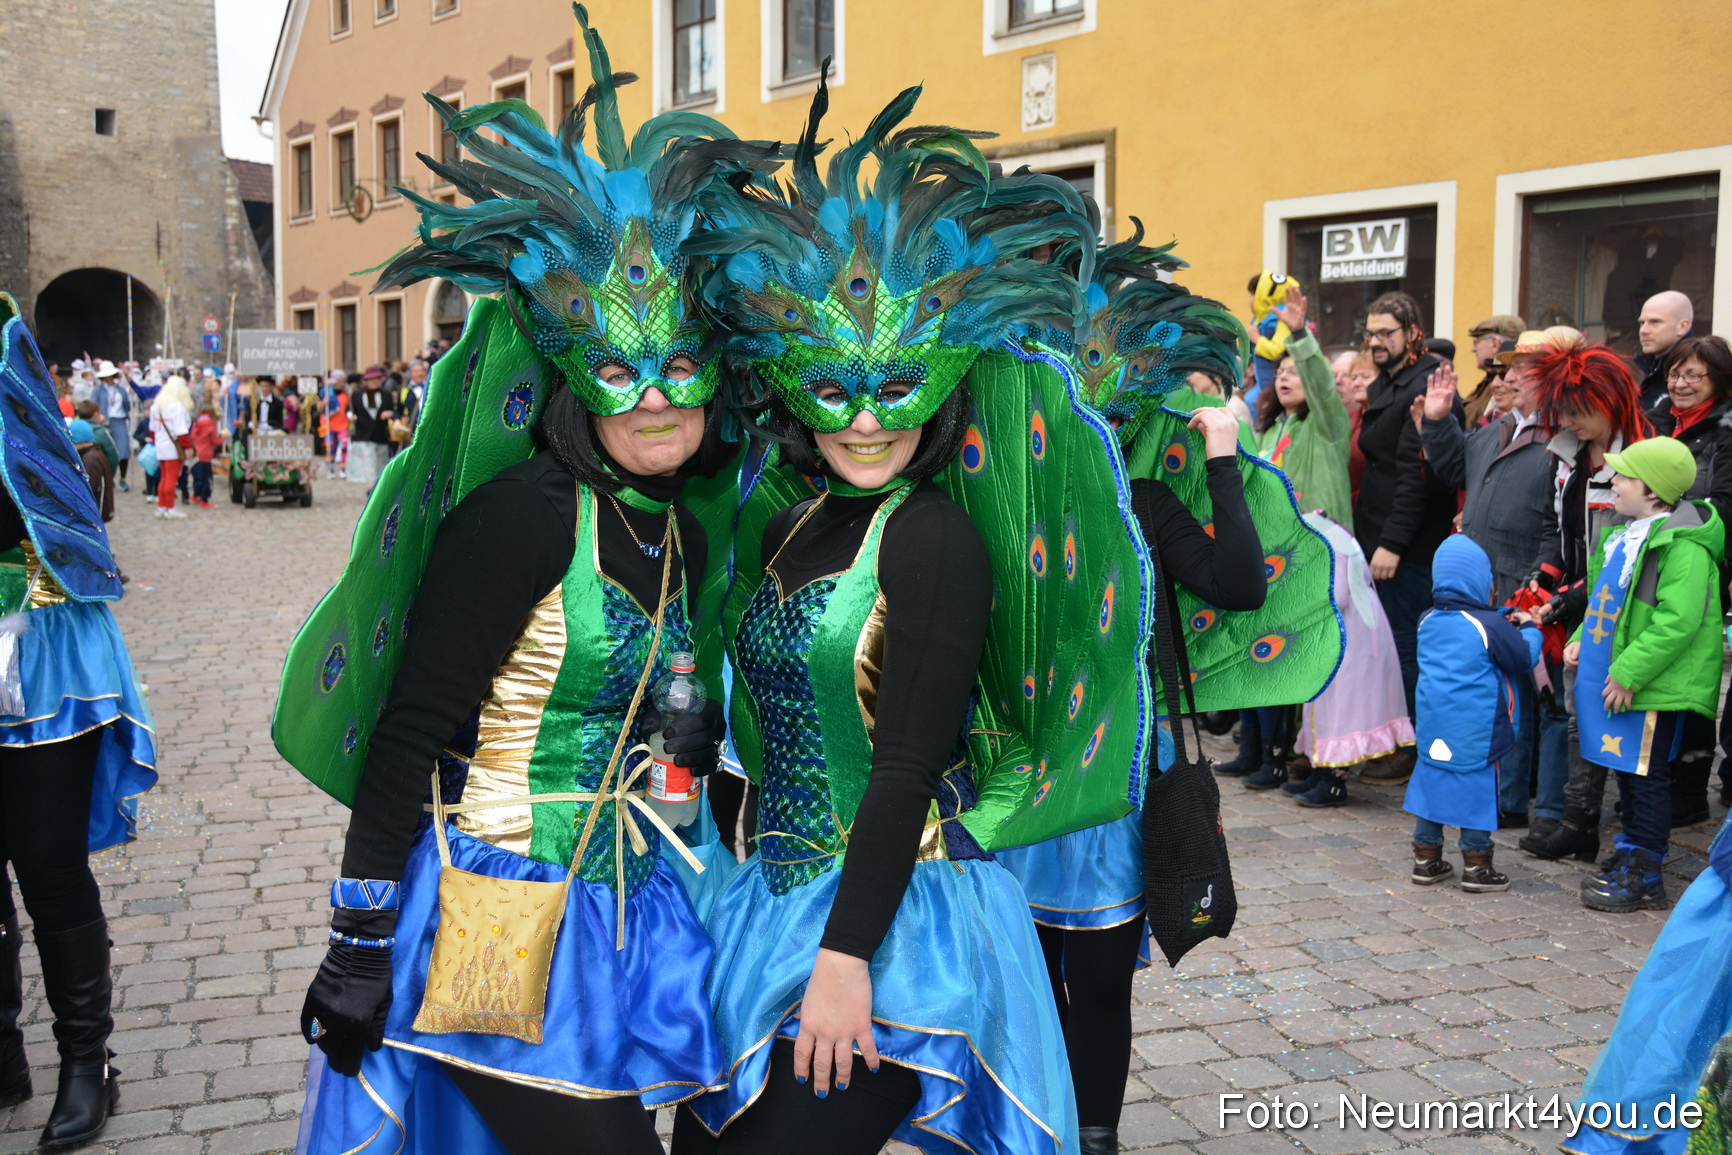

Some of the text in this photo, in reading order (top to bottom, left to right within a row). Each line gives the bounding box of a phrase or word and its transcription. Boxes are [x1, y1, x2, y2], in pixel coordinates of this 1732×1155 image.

[1326, 223, 1401, 258] BW
[1321, 260, 1404, 279] Bekleidung
[266, 361, 297, 371] PARK
